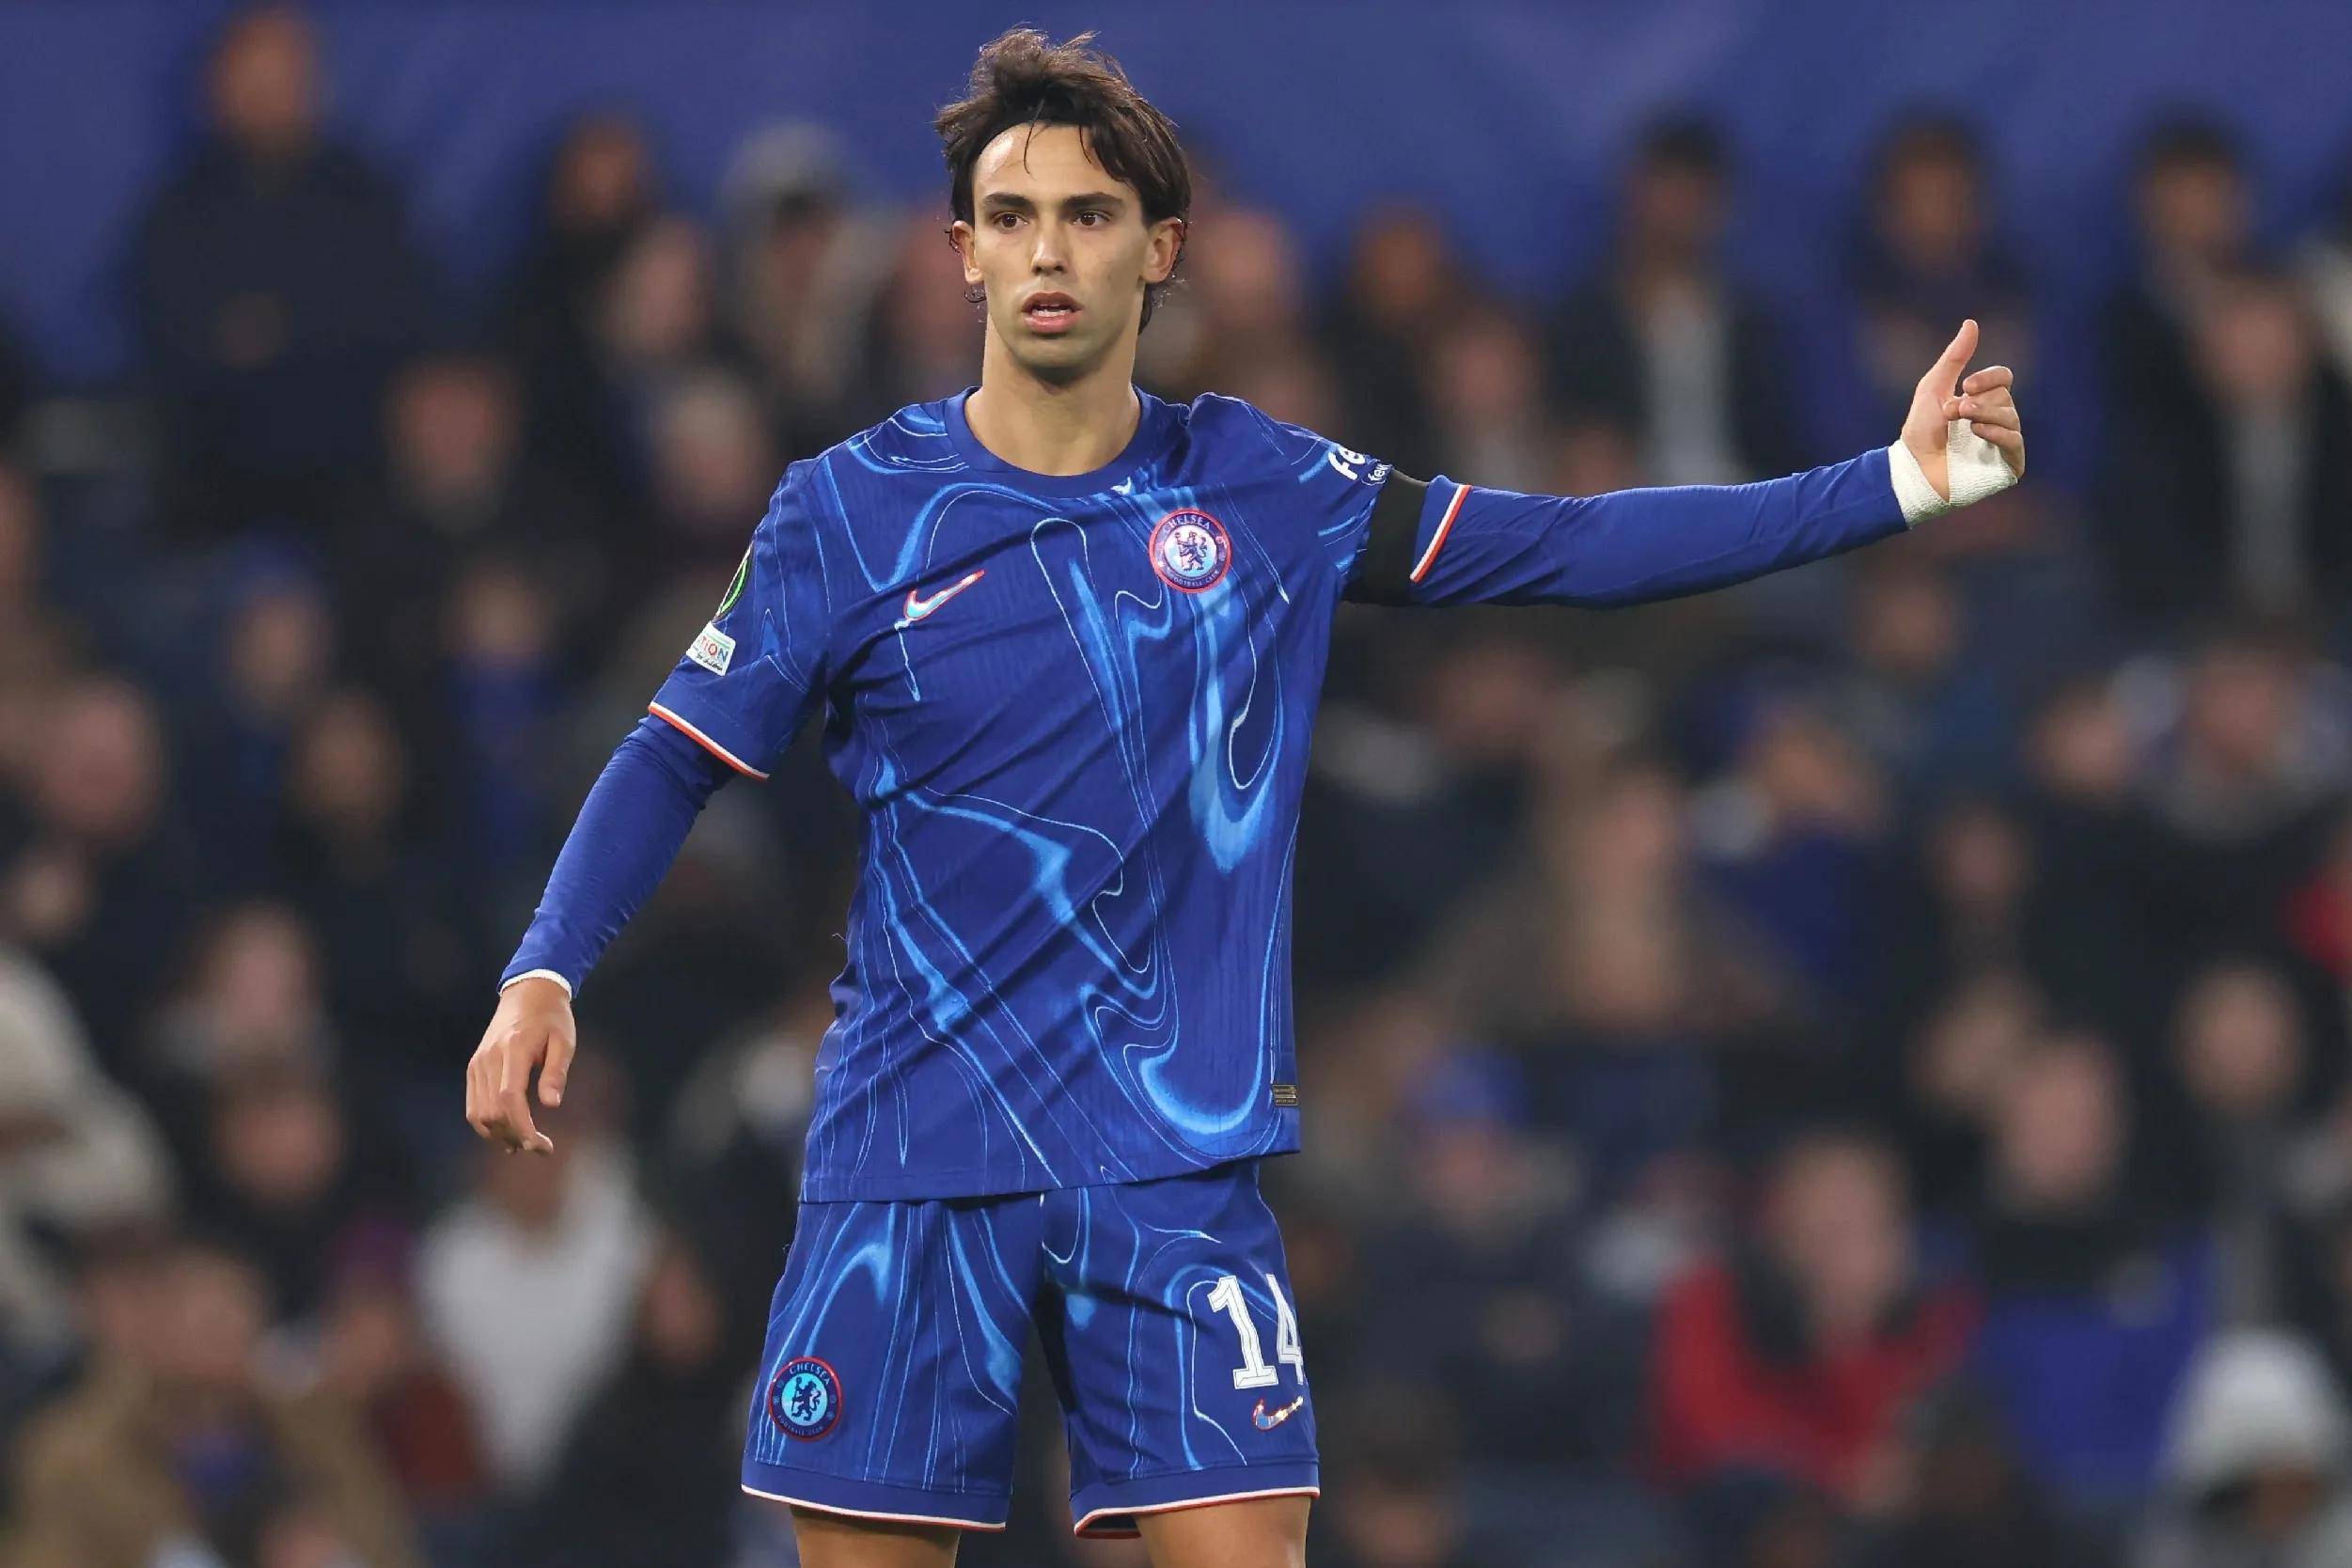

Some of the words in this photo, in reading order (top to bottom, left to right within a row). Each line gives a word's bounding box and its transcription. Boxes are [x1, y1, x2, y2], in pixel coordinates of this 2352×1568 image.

[1164, 514, 1210, 532] CHELSEA
[1207, 1274, 1304, 1390] 14
[789, 1362, 831, 1385] CHELSEA
